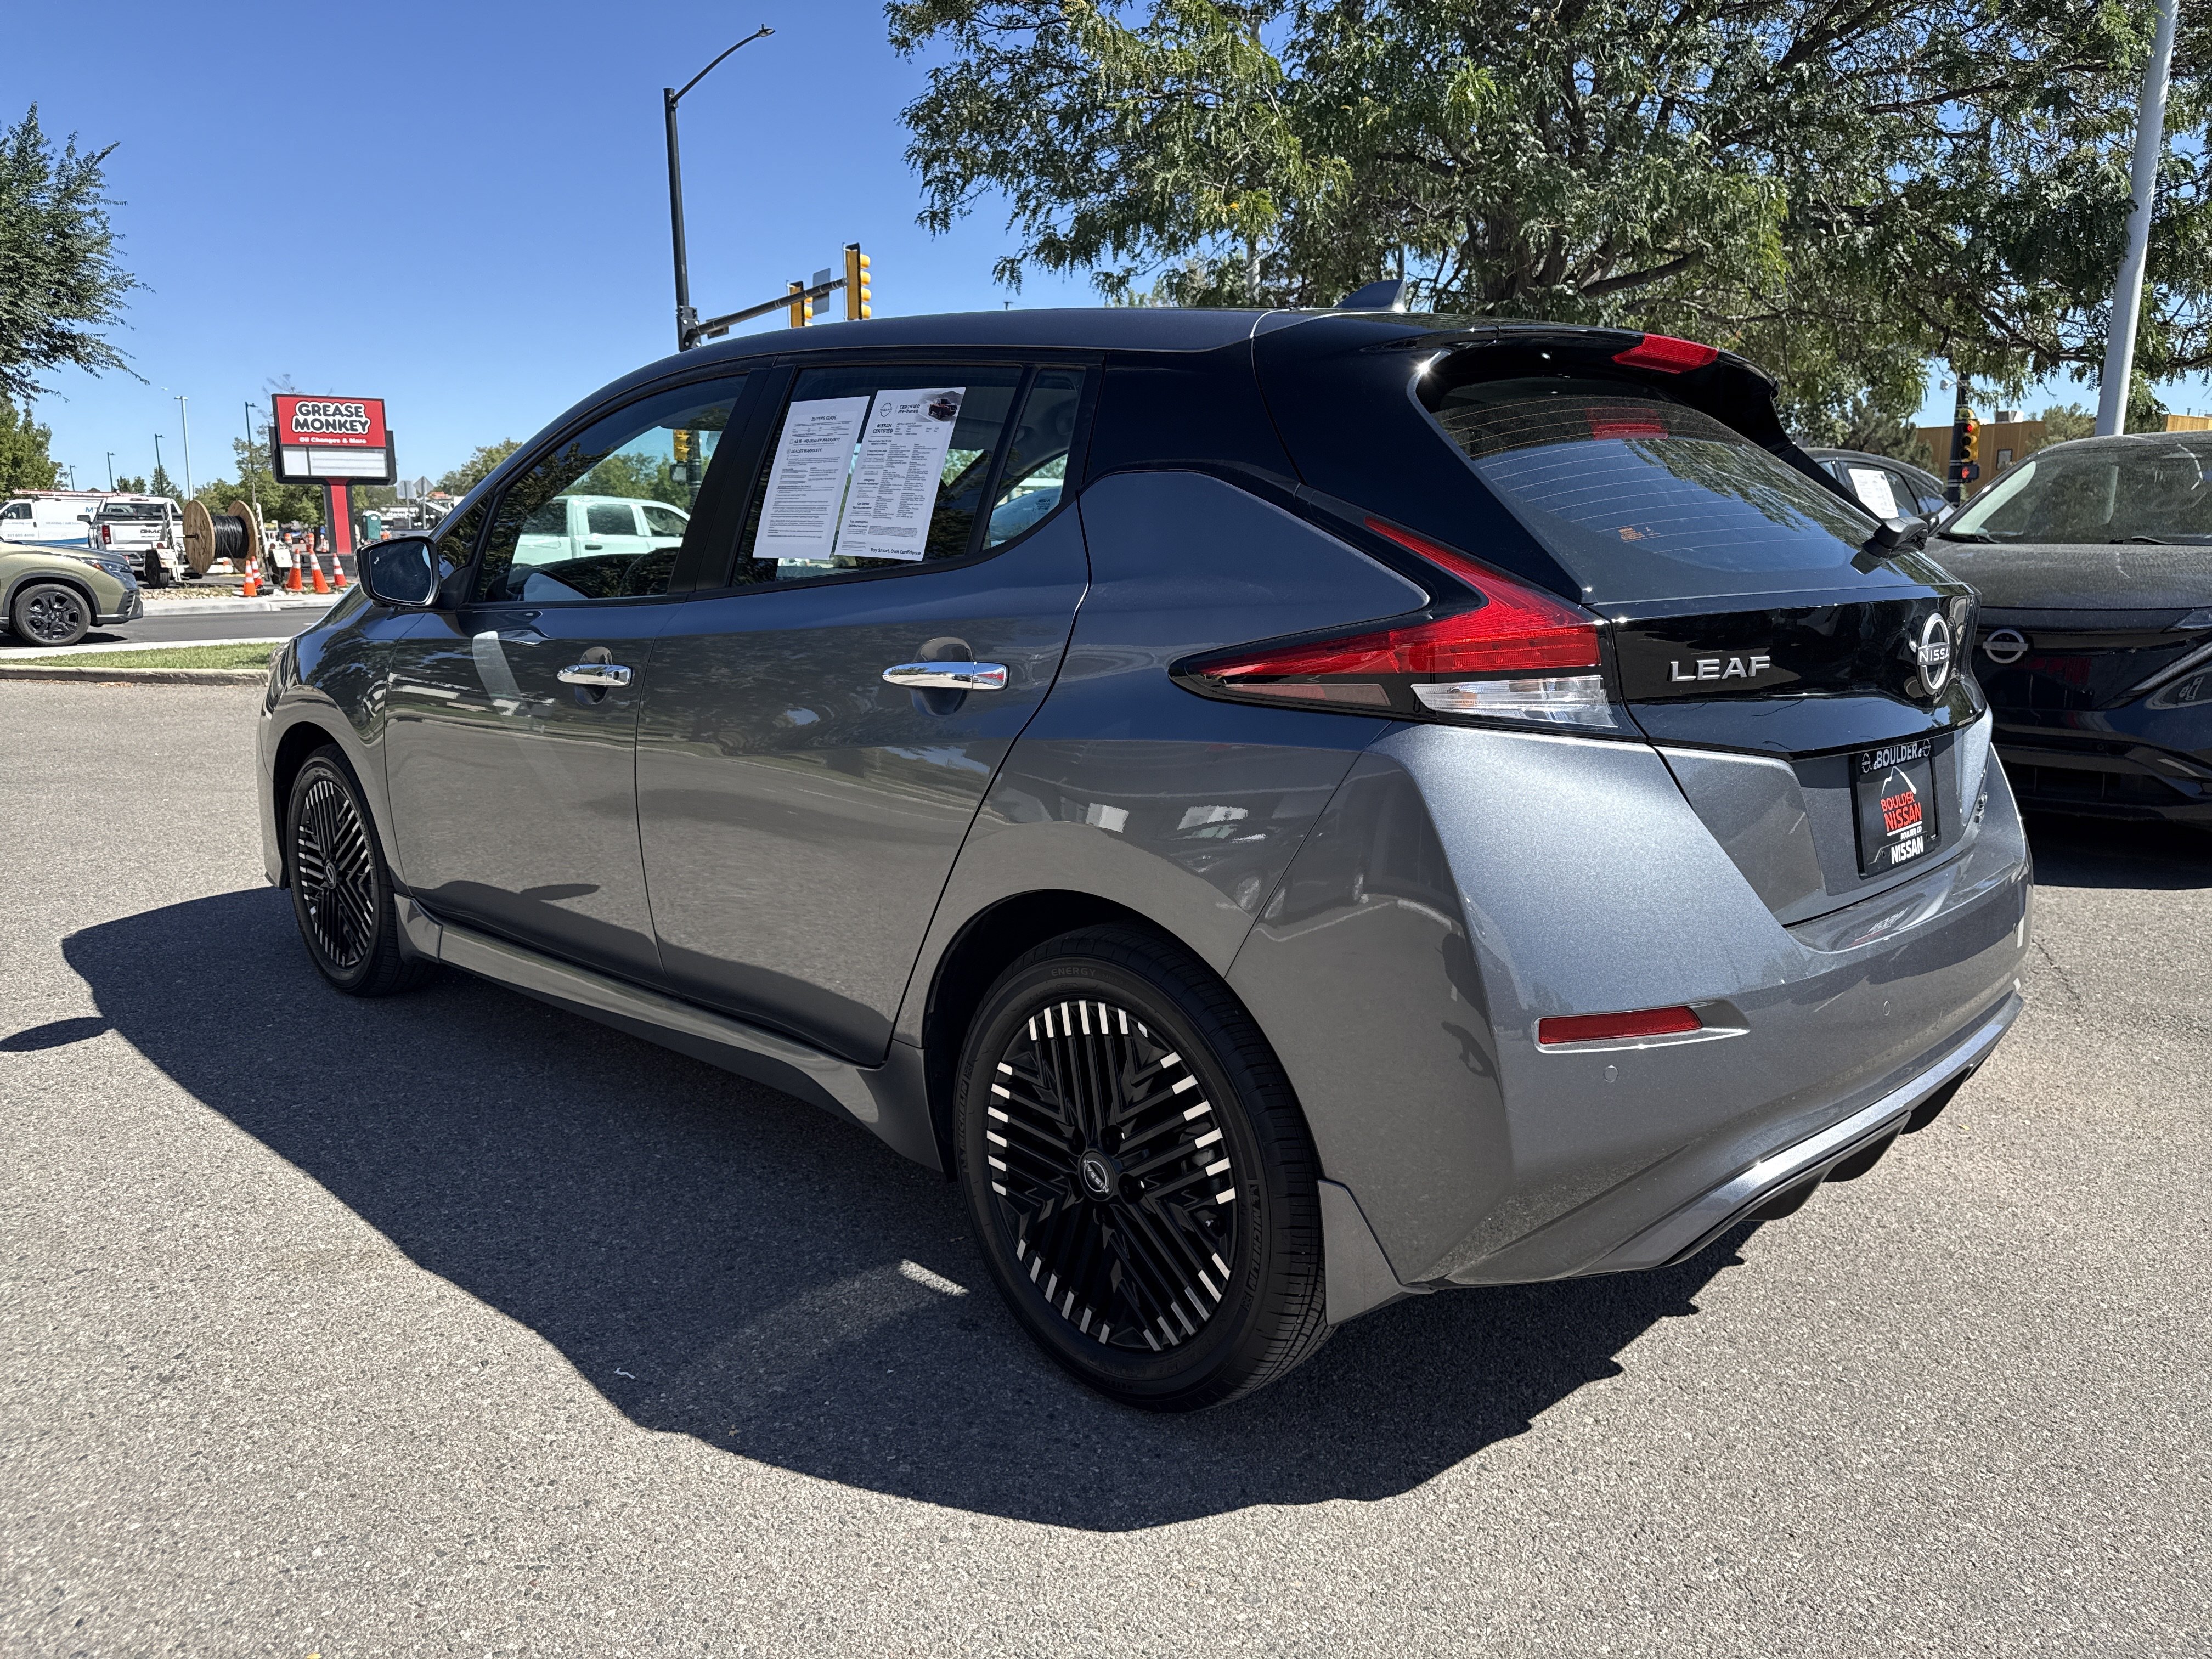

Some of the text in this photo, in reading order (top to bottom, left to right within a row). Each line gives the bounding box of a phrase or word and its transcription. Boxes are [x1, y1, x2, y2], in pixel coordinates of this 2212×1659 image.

[297, 403, 364, 419] GREASE
[294, 417, 369, 432] MONKEY
[1919, 647, 1950, 663] NISSA
[1670, 656, 1771, 682] LEAF
[1876, 742, 1918, 769] BOULDER
[1880, 791, 1915, 812] BOULDER
[1883, 802, 1922, 832] NISSAN
[1891, 835, 1924, 865] NISSAN
[1051, 967, 1097, 977] ENERGY
[958, 1079, 969, 1152] MICHELIN
[1083, 1158, 1110, 1194] NISSAN
[1248, 1206, 1262, 1291] MICHELIN
